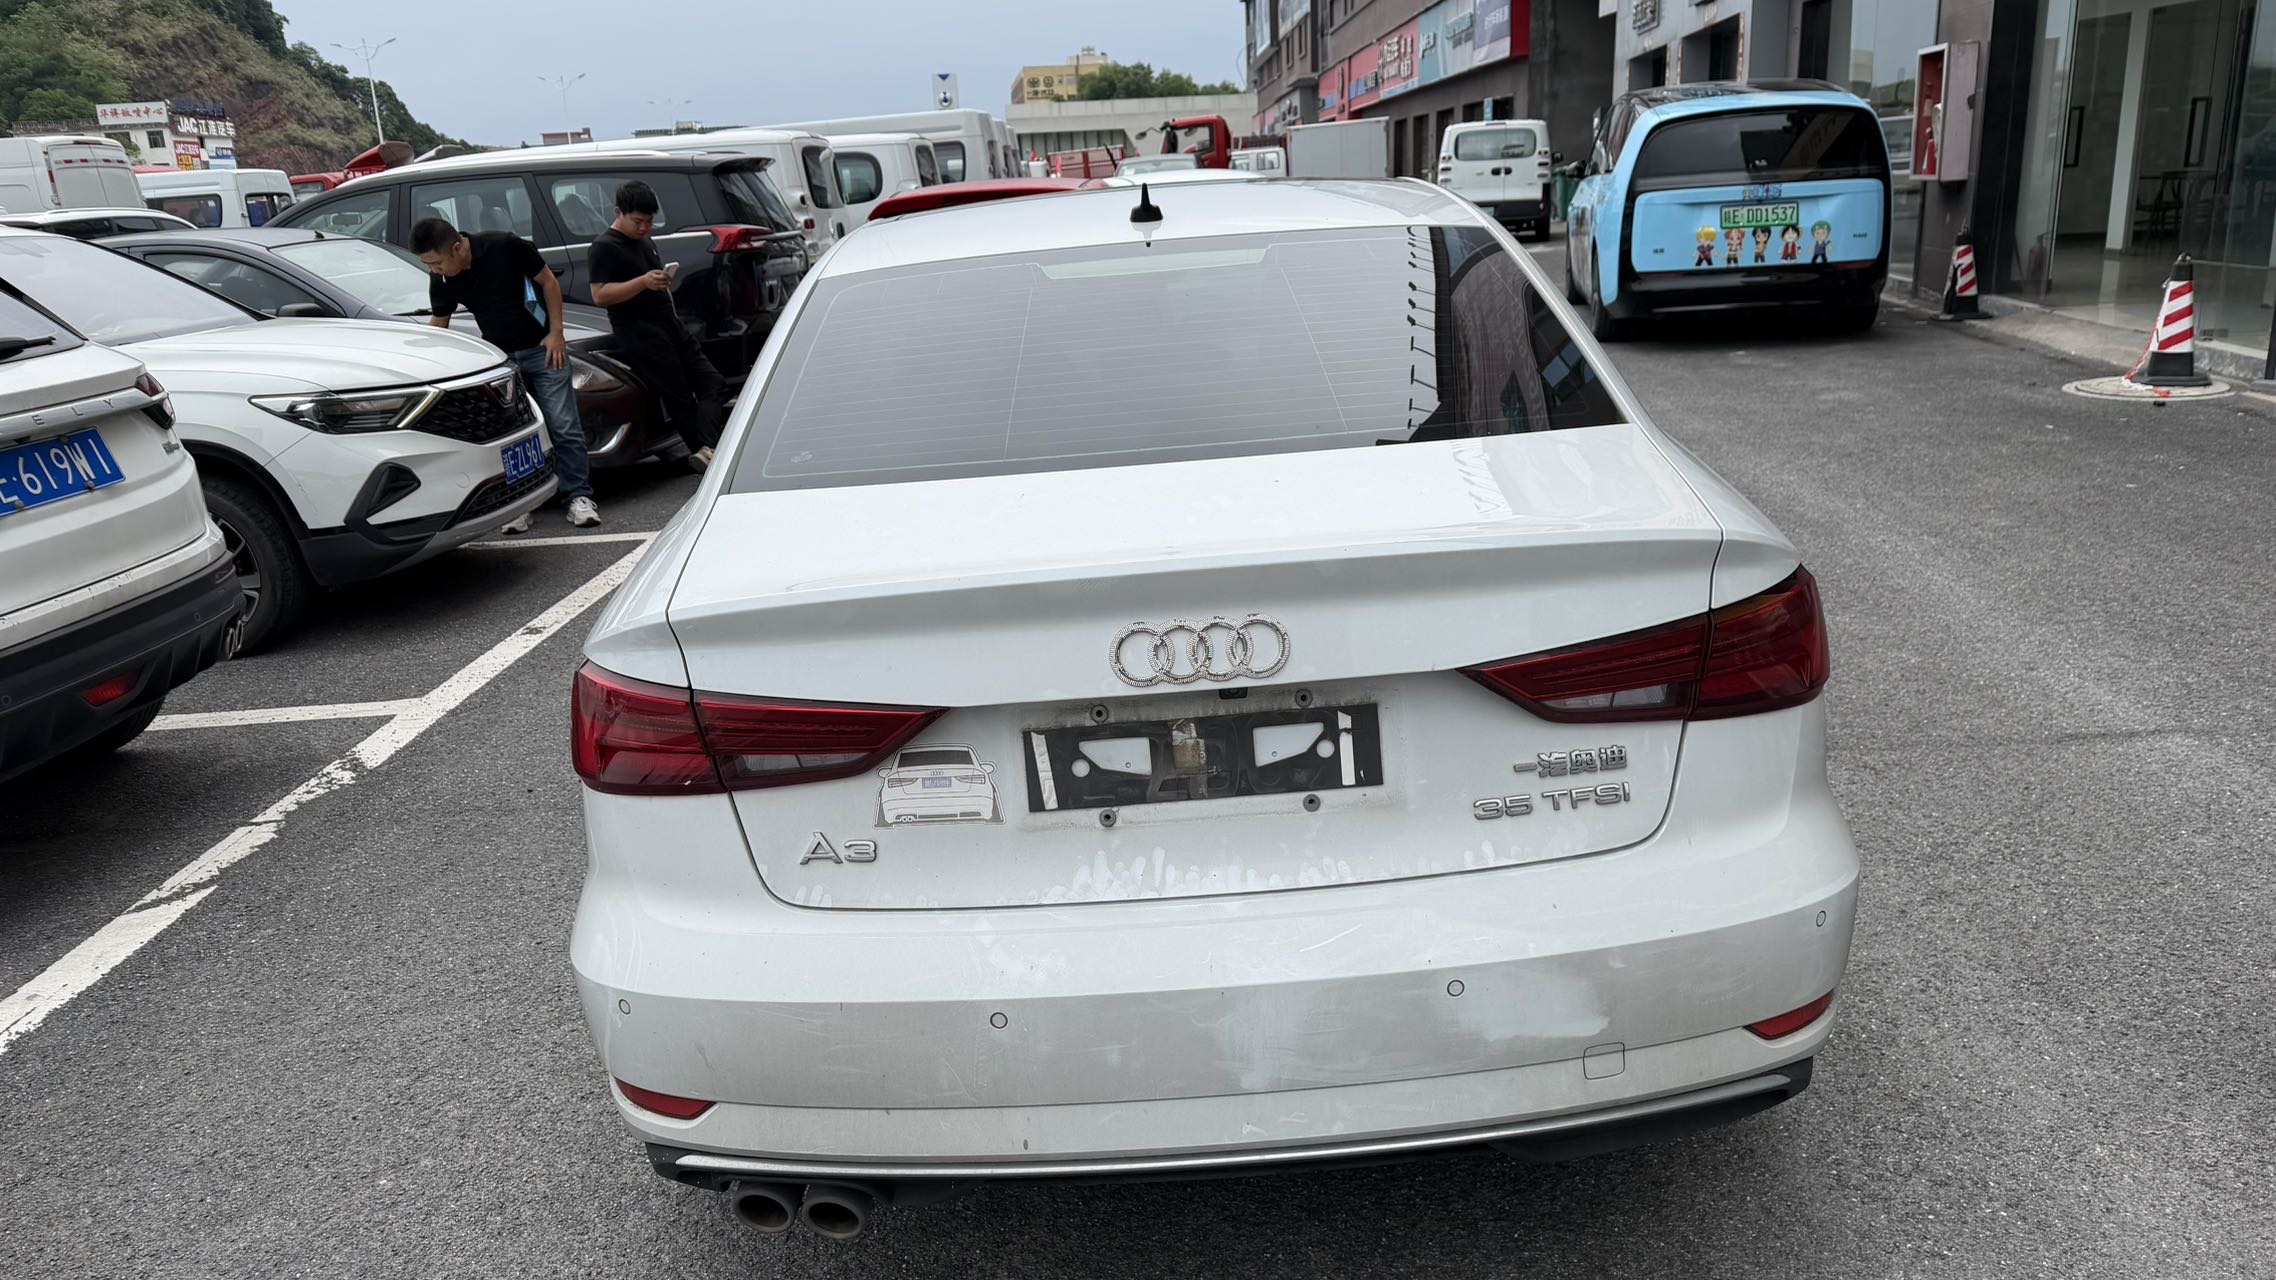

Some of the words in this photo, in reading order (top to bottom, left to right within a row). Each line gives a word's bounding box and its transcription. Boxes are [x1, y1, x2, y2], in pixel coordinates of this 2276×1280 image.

[1513, 744, 1628, 778] 一汽奥迪
[1473, 794, 1533, 820] 35
[1541, 781, 1631, 811] TFSI
[800, 831, 878, 866] A3
